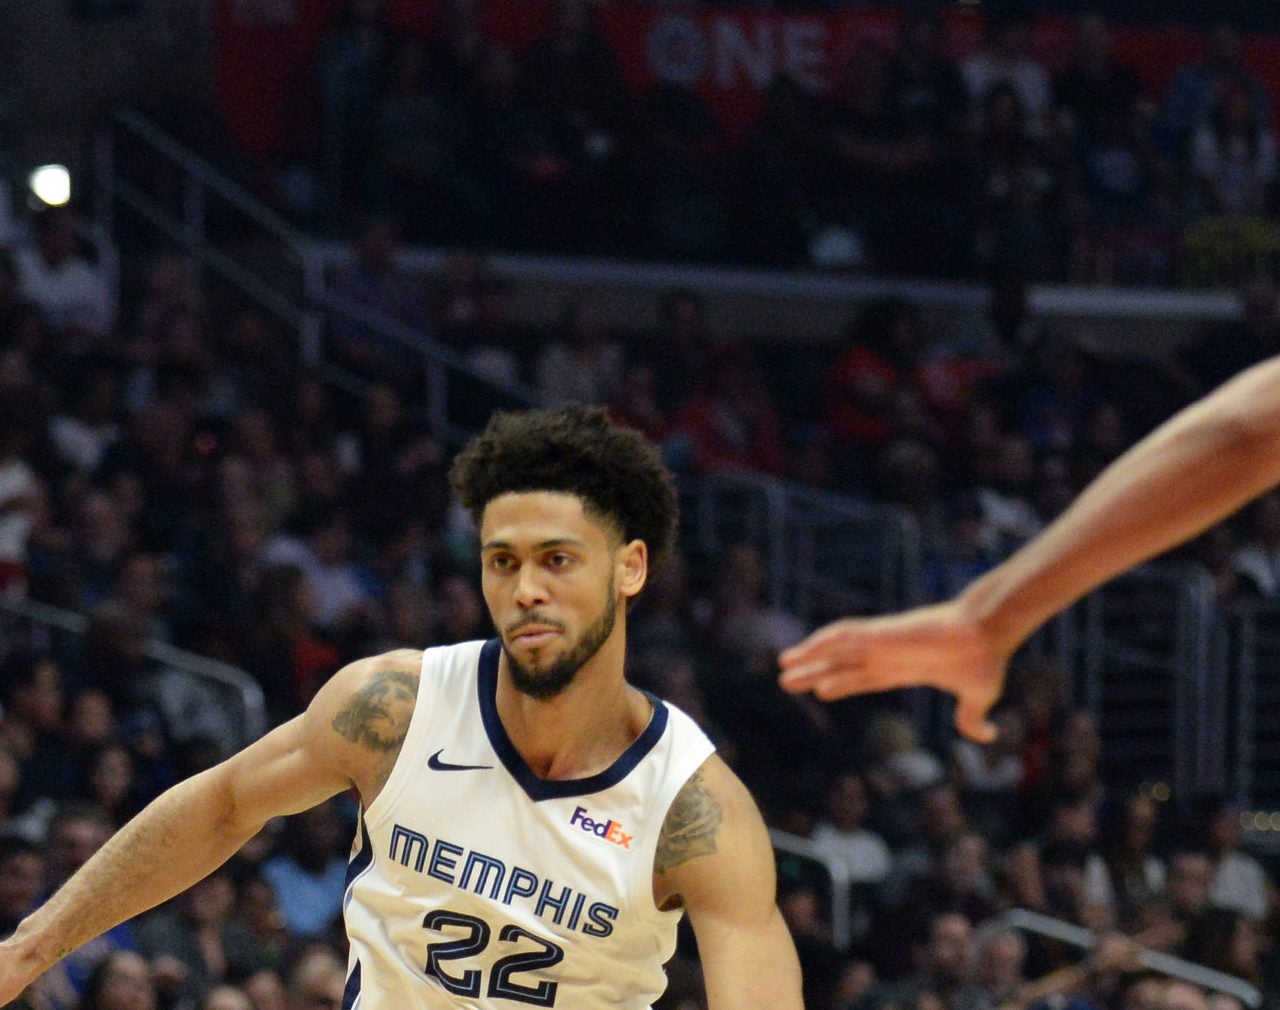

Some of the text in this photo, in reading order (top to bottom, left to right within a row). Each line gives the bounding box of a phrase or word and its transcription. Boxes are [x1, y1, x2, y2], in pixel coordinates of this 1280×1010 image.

[645, 14, 826, 93] ONE
[569, 806, 634, 849] FedEx
[389, 824, 619, 938] MEMPHIS
[422, 909, 564, 1008] 22
